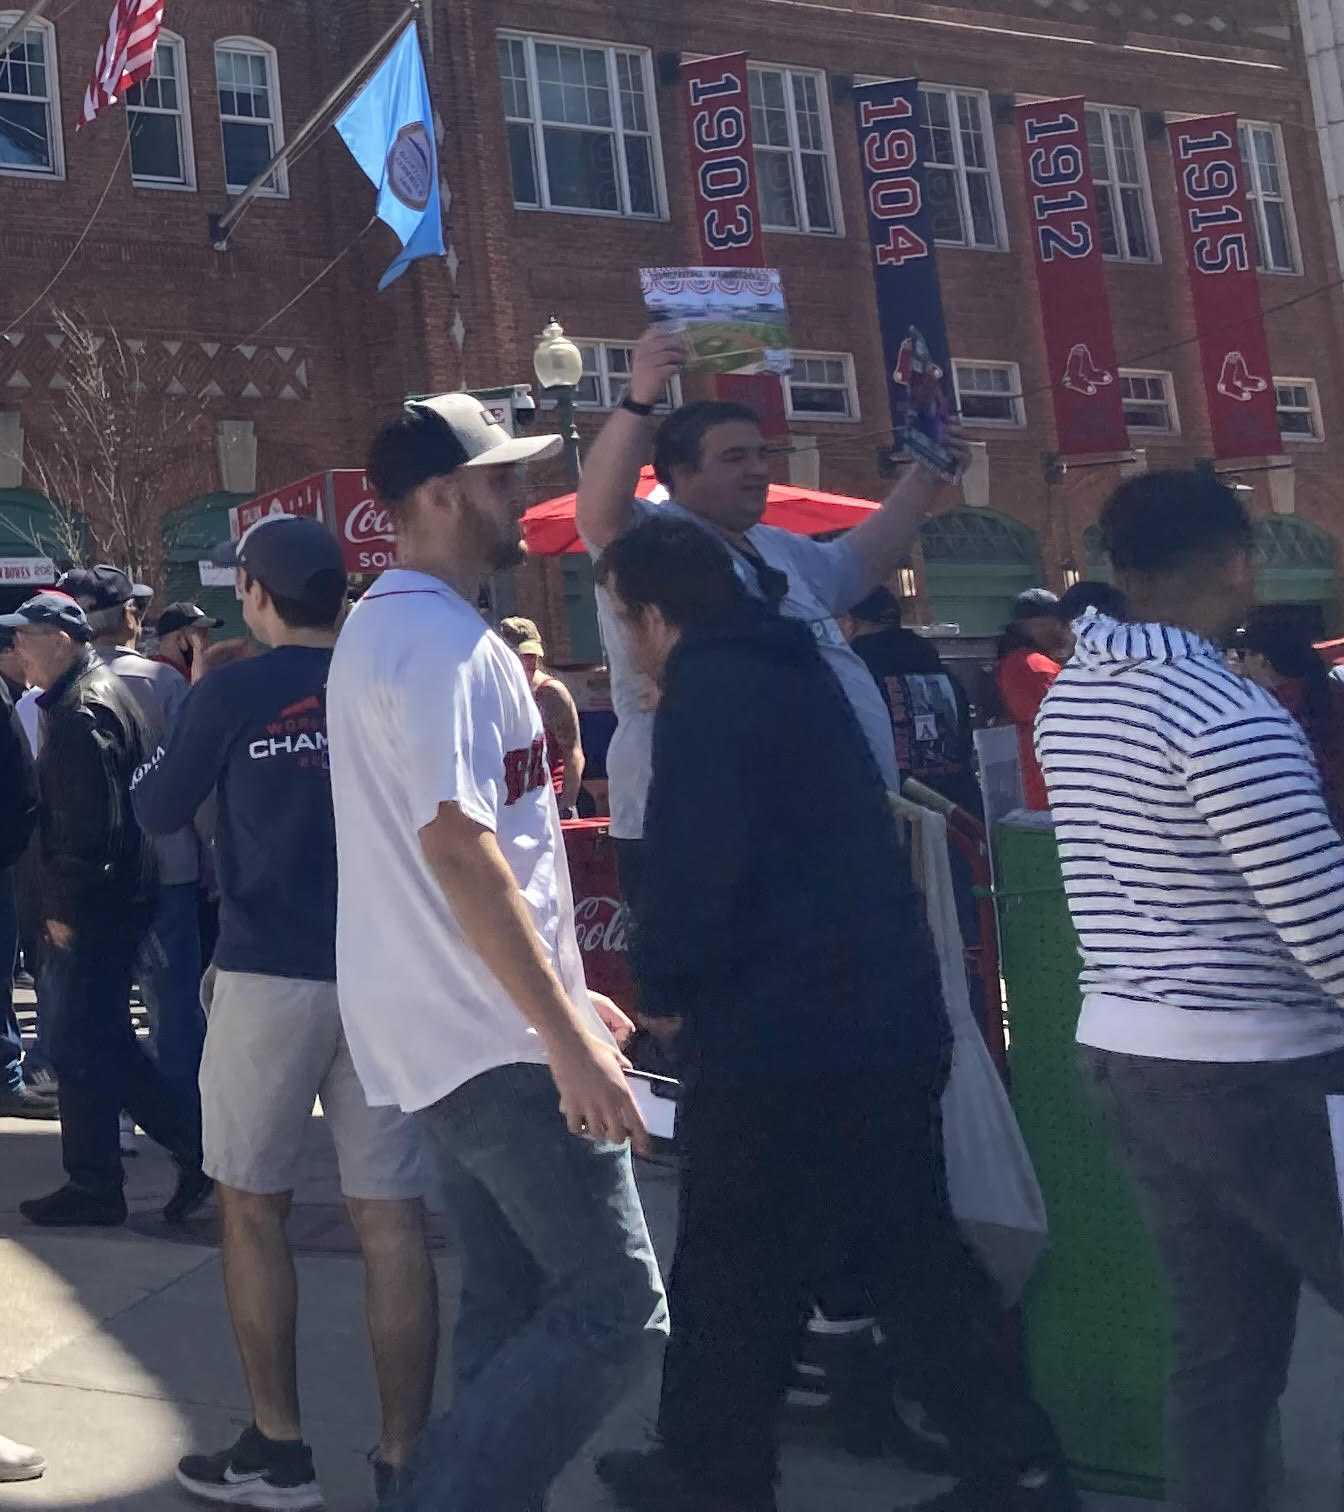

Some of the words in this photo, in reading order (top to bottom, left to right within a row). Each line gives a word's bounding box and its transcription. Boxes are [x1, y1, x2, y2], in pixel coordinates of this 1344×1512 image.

[688, 72, 754, 252] 1903
[859, 96, 929, 267] 1904
[1025, 112, 1093, 263] 1912
[1177, 129, 1250, 276] 1915
